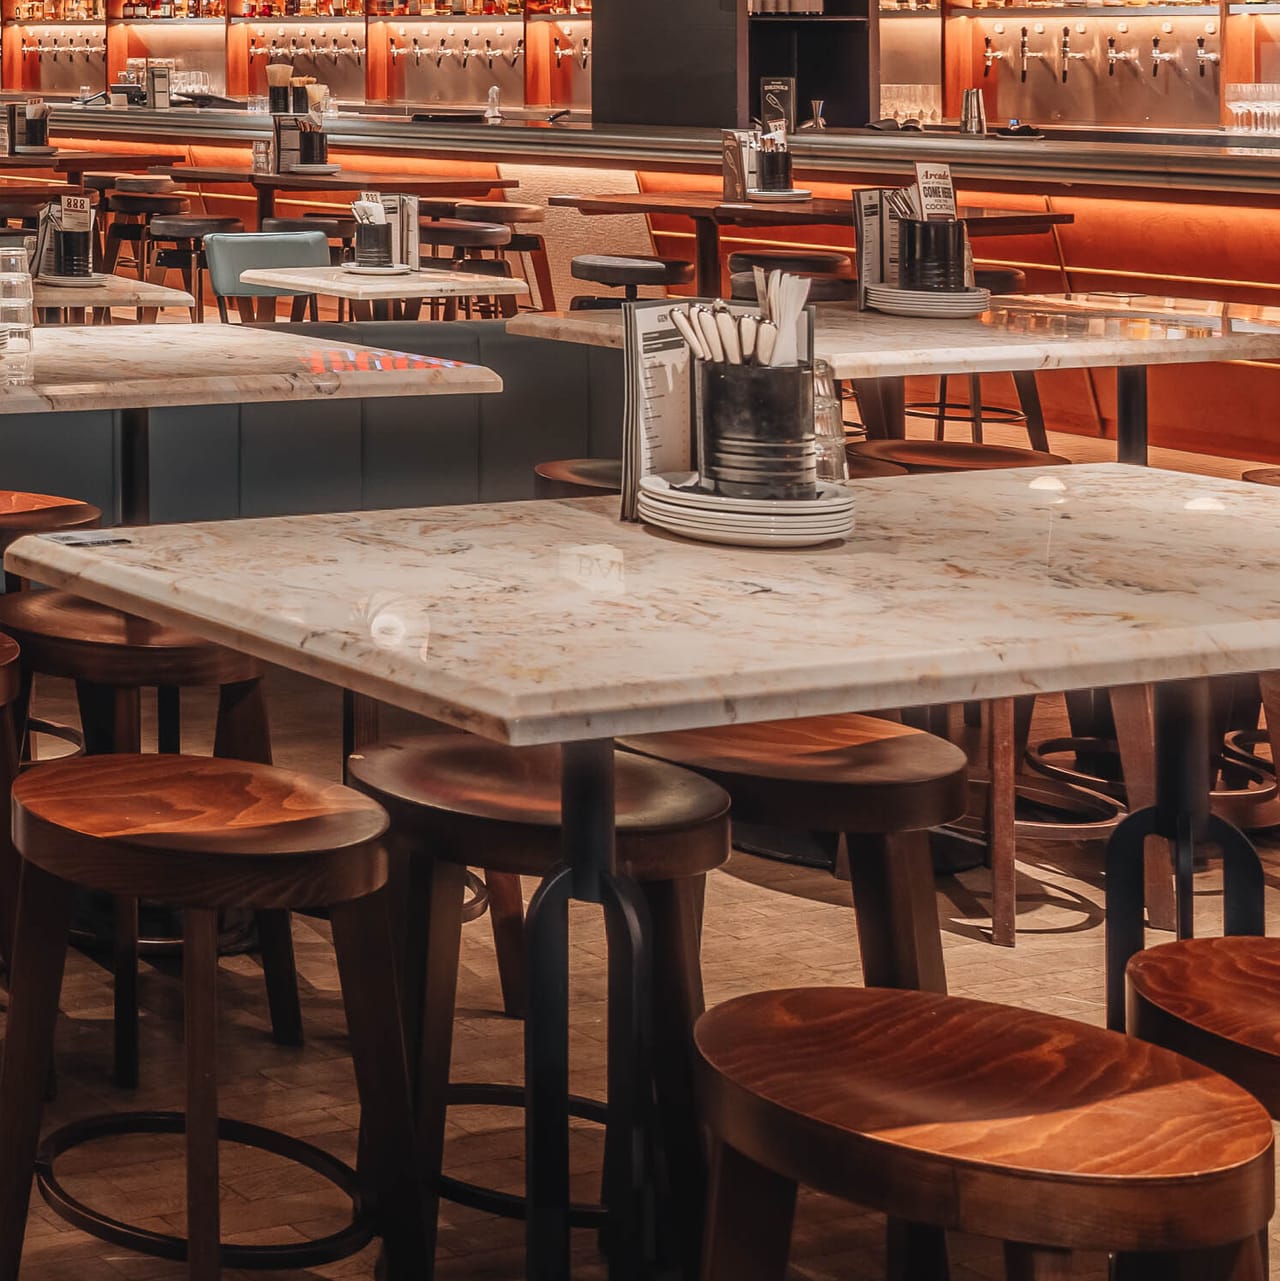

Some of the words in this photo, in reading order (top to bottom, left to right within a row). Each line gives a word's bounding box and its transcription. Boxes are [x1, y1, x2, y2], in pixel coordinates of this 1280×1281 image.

[921, 170, 949, 181] Arcade
[923, 186, 941, 198] COME
[66, 197, 85, 210] 888
